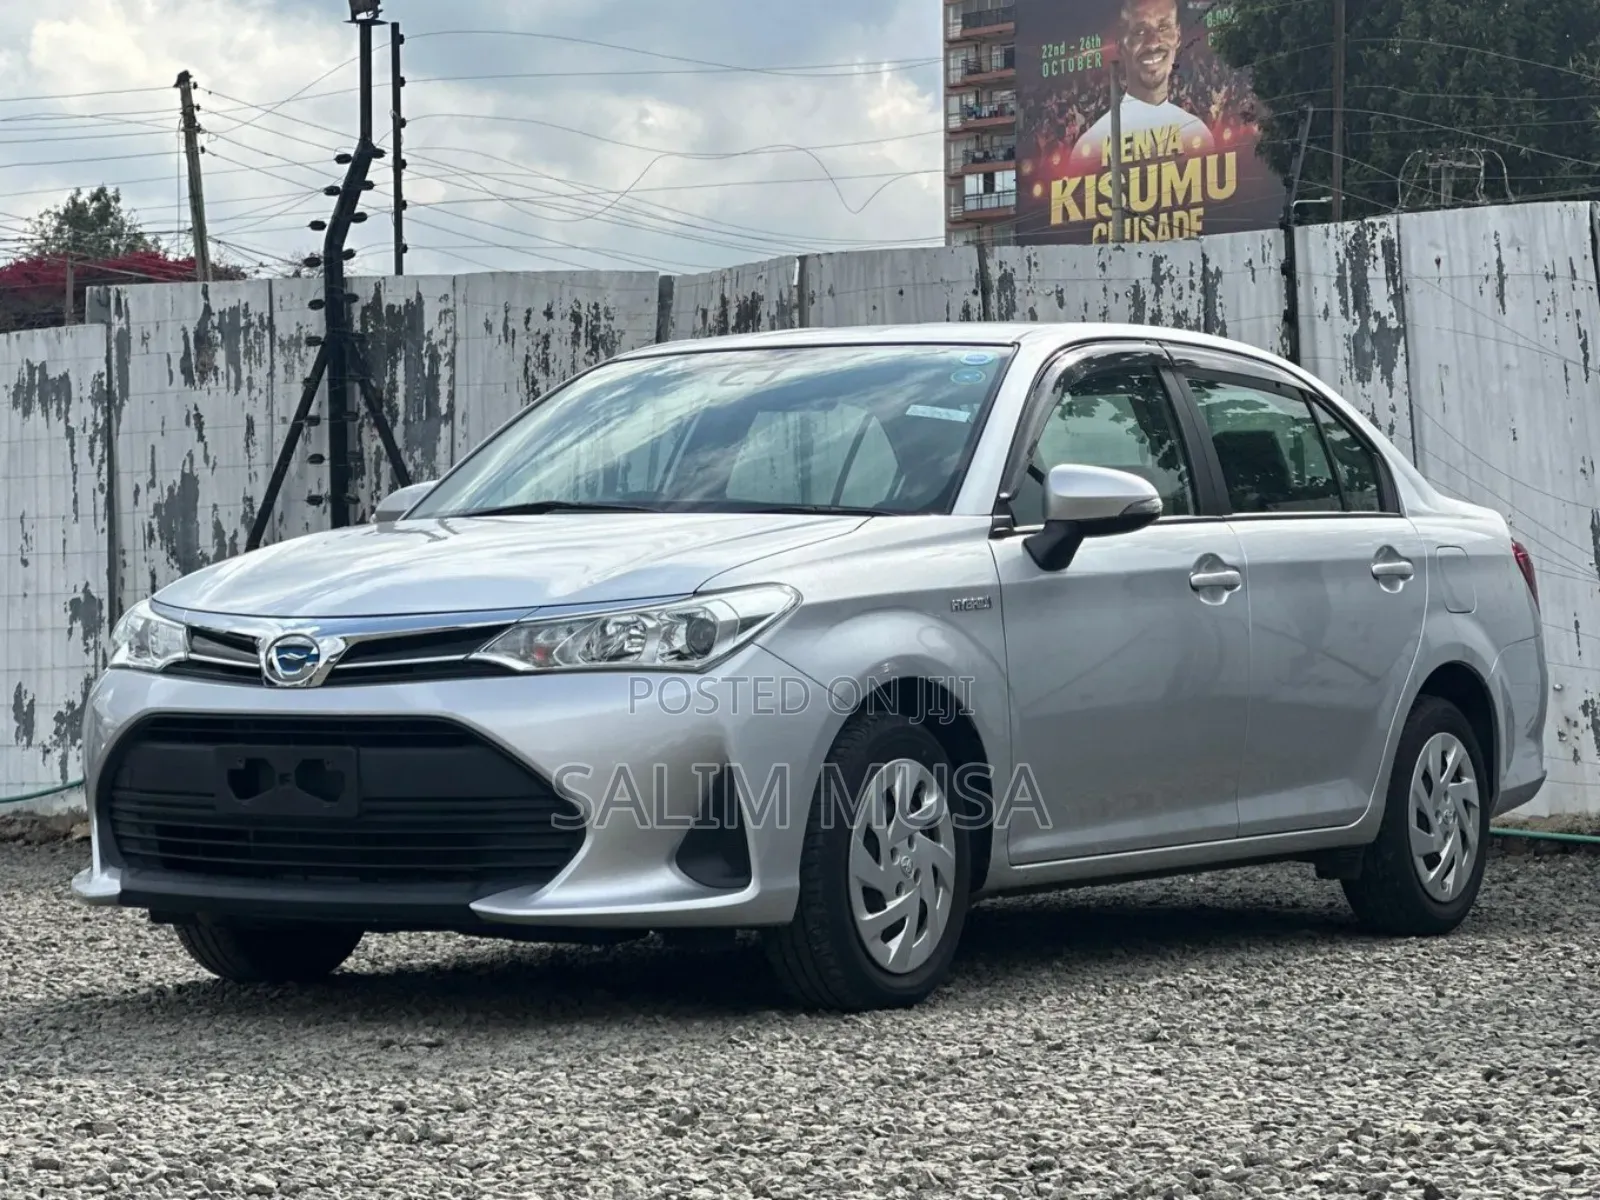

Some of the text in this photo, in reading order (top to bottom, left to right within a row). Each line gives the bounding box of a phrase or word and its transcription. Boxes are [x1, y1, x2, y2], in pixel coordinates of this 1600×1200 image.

[1041, 41, 1066, 59] 22nd
[1080, 34, 1101, 51] 26th
[1042, 52, 1102, 78] OCTOBER
[1051, 152, 1237, 224] KISUMU
